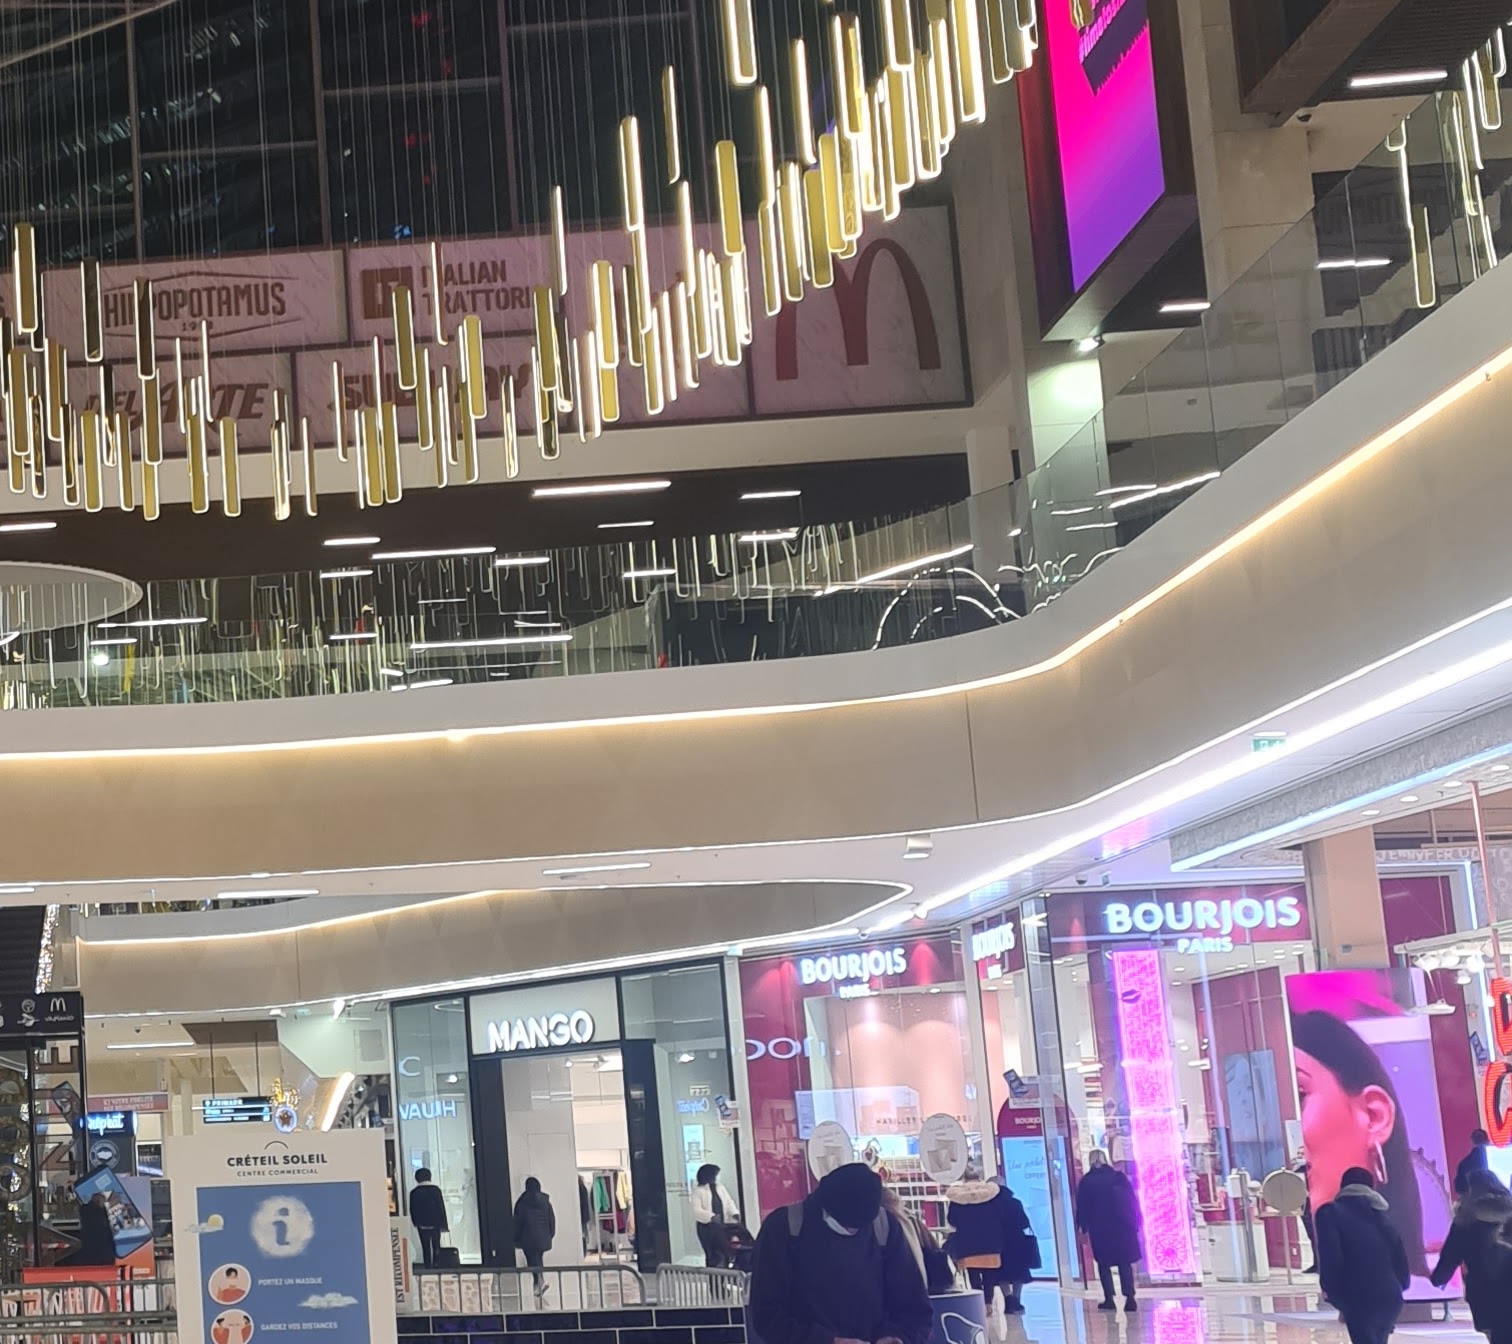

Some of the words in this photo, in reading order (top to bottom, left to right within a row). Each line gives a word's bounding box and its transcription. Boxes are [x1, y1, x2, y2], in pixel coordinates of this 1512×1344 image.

[420, 259, 507, 288] IALIAN
[104, 282, 287, 329] HIOPOTAMUS
[421, 287, 531, 316] TRATTORI
[153, 376, 269, 433] ATE
[1105, 896, 1301, 935] BOURJOIS
[1176, 936, 1234, 954] PARIS
[800, 947, 907, 984] BOURJOIS
[488, 1009, 595, 1053] MANGO
[226, 1154, 279, 1167] CRÉTEIL
[282, 1153, 328, 1165] SOLEIL
[268, 1168, 319, 1176] COMMERCIAL
